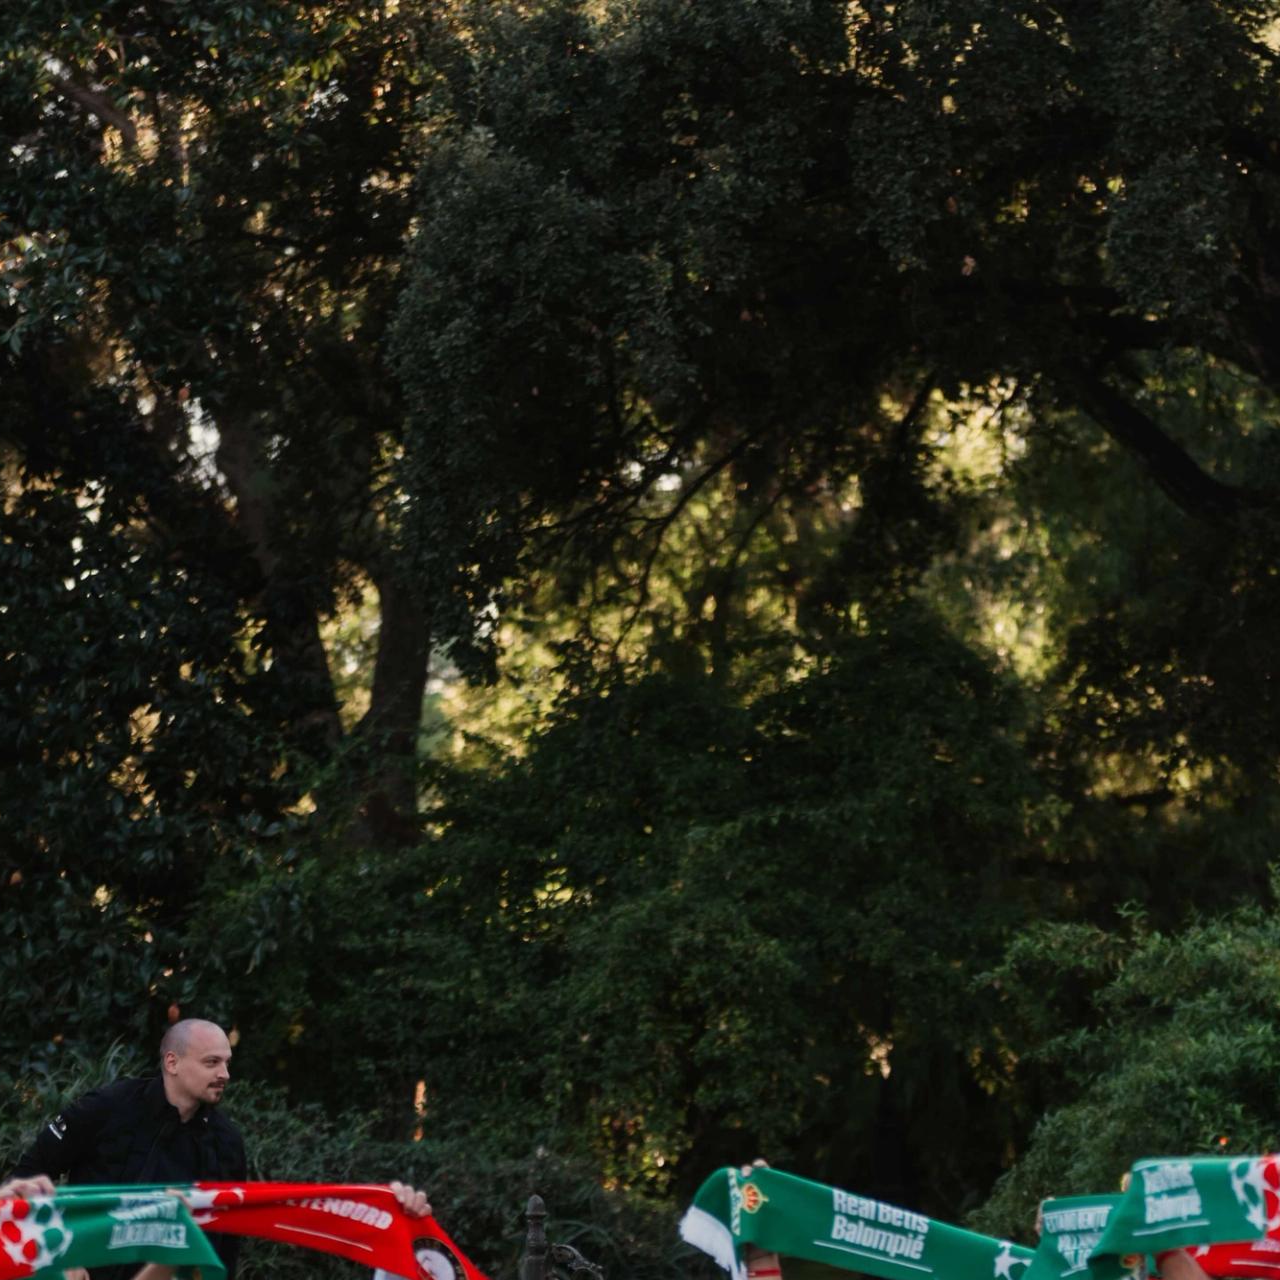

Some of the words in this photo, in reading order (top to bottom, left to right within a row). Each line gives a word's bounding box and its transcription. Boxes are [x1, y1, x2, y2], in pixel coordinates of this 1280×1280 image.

[832, 1186, 877, 1221] Real
[877, 1201, 930, 1234] Betis
[831, 1213, 926, 1260] Balompié
